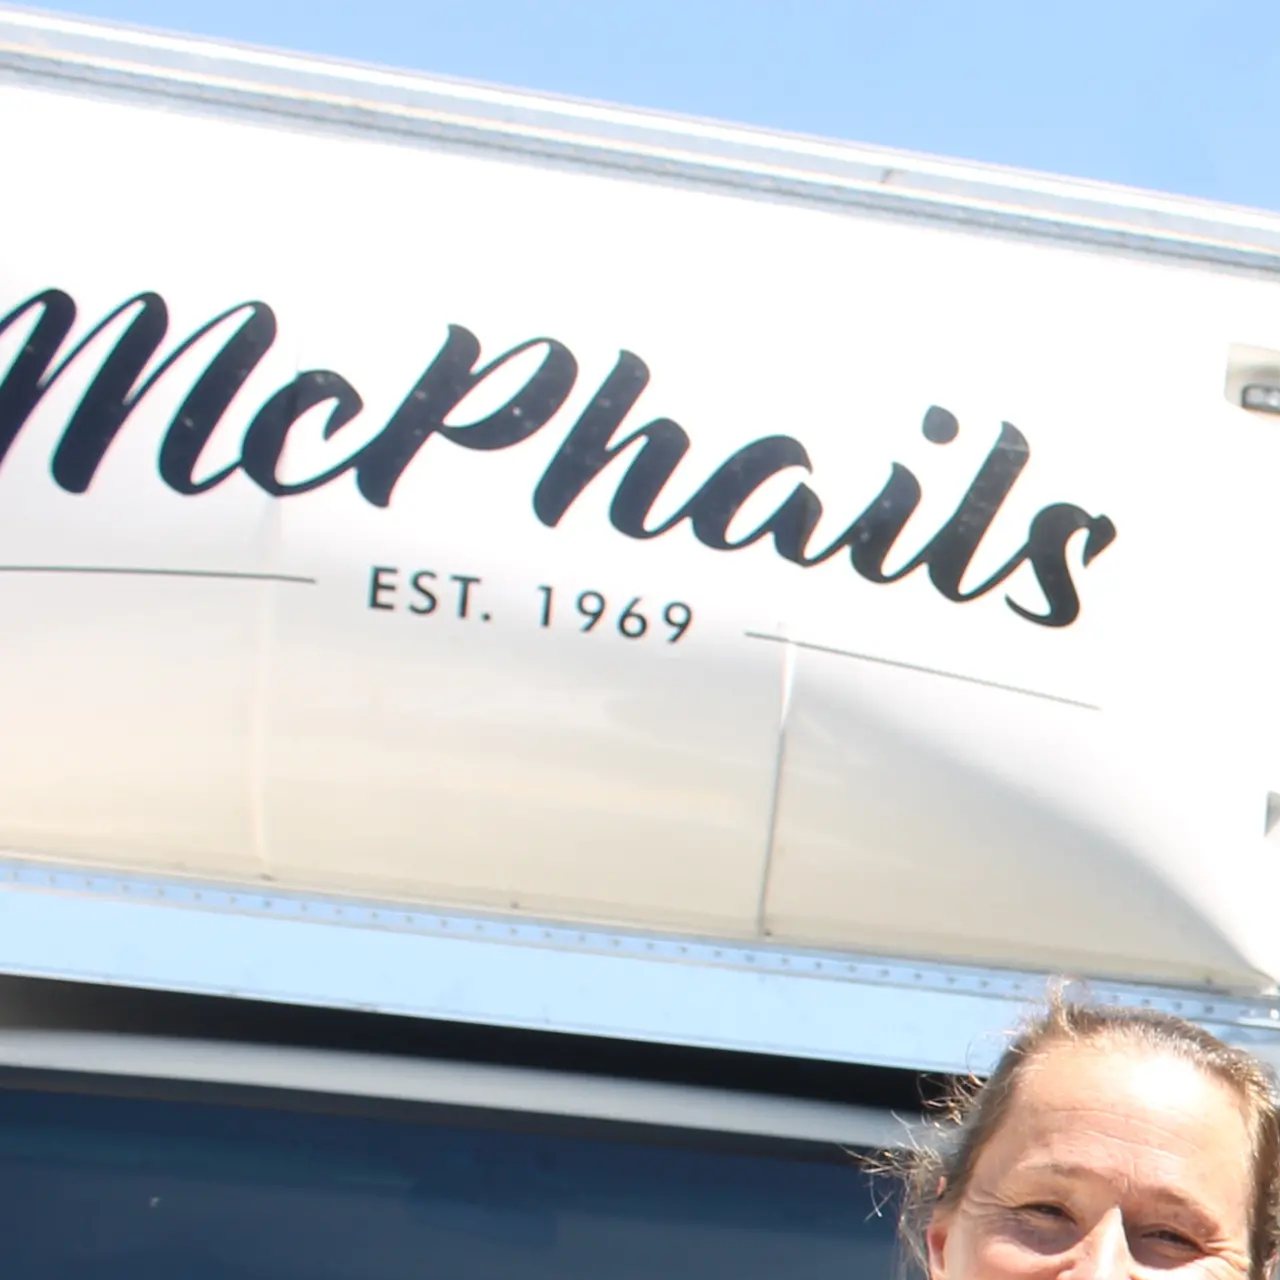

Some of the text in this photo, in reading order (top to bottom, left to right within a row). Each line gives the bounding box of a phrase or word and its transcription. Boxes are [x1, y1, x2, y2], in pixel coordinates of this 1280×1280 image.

[0, 289, 1117, 628] McPhails
[367, 565, 694, 645] EST. 1969
